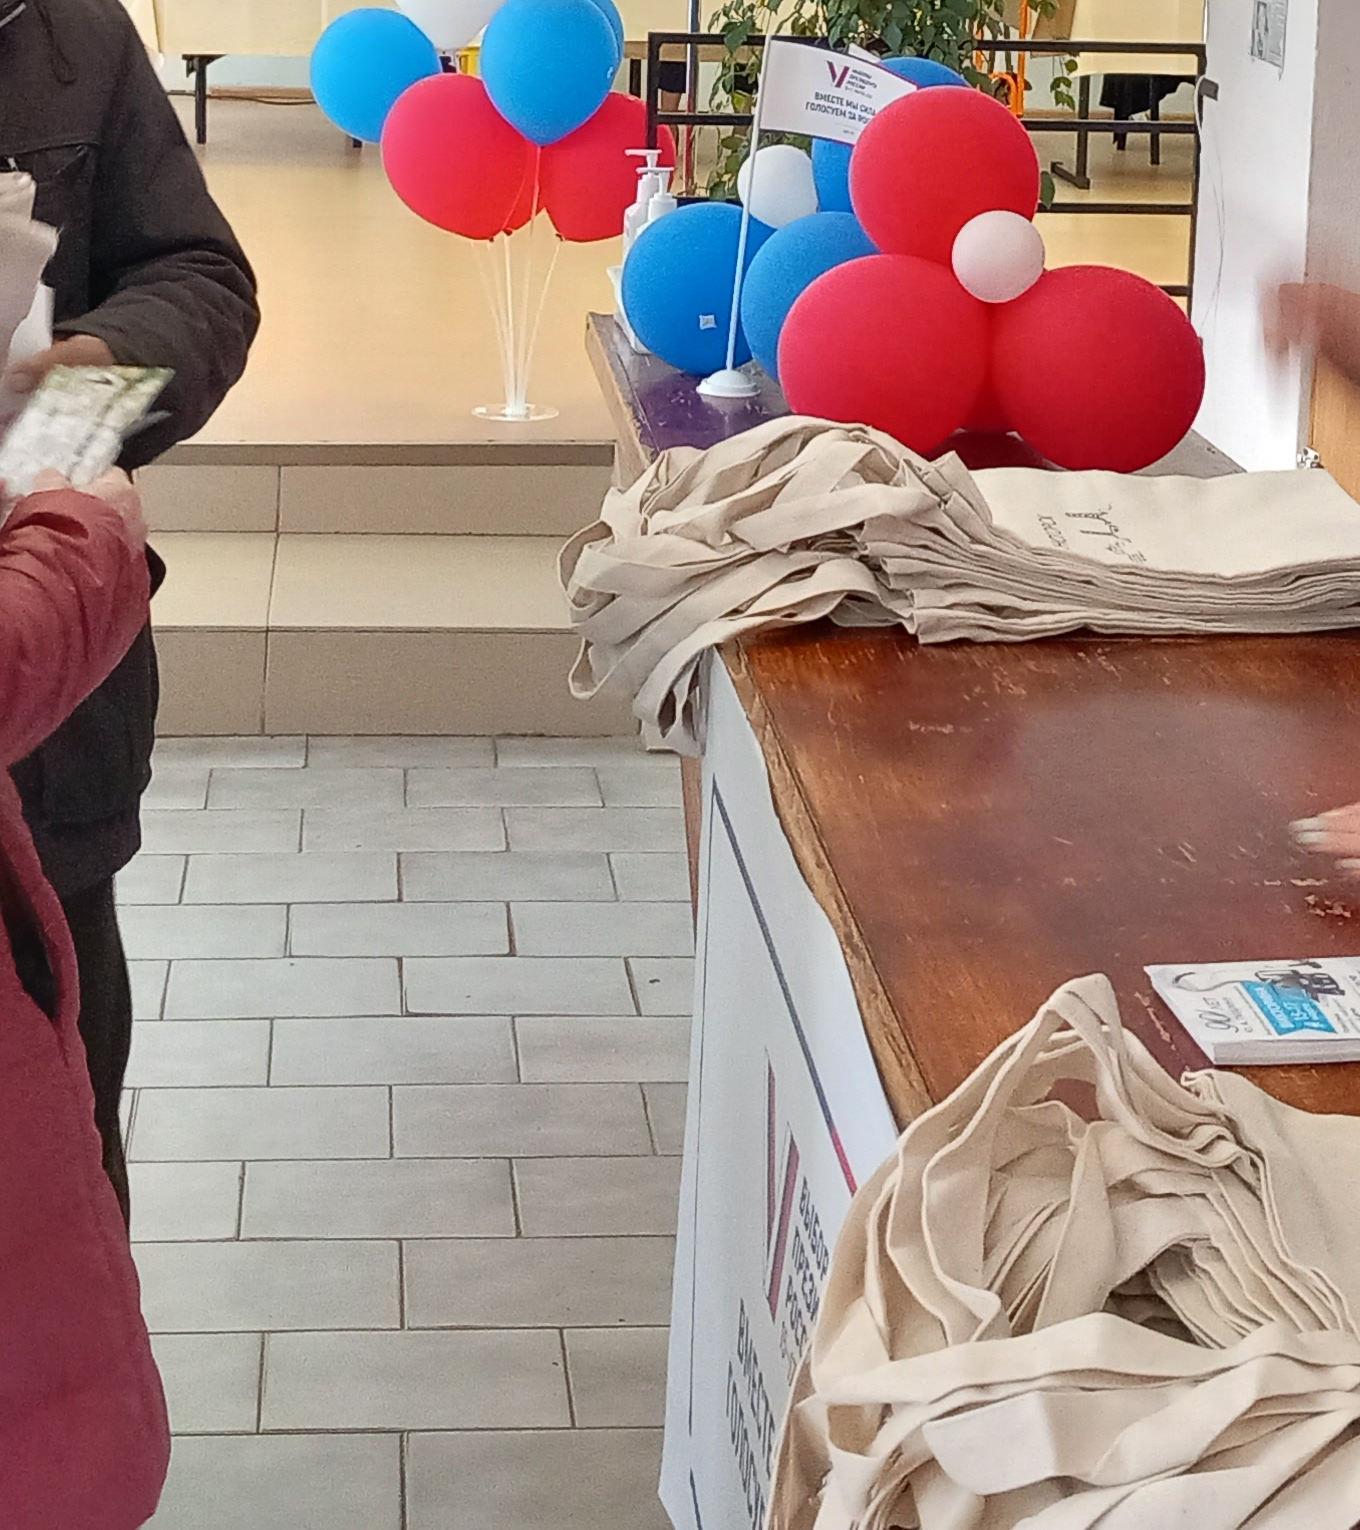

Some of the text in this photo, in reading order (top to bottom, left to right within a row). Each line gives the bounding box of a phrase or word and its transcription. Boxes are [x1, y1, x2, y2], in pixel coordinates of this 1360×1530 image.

[814, 91, 844, 107] ВМЕСТЕ
[805, 101, 847, 118] ГОЛОСУЕМ
[737, 1297, 776, 1481] ВМЕСТЕ
